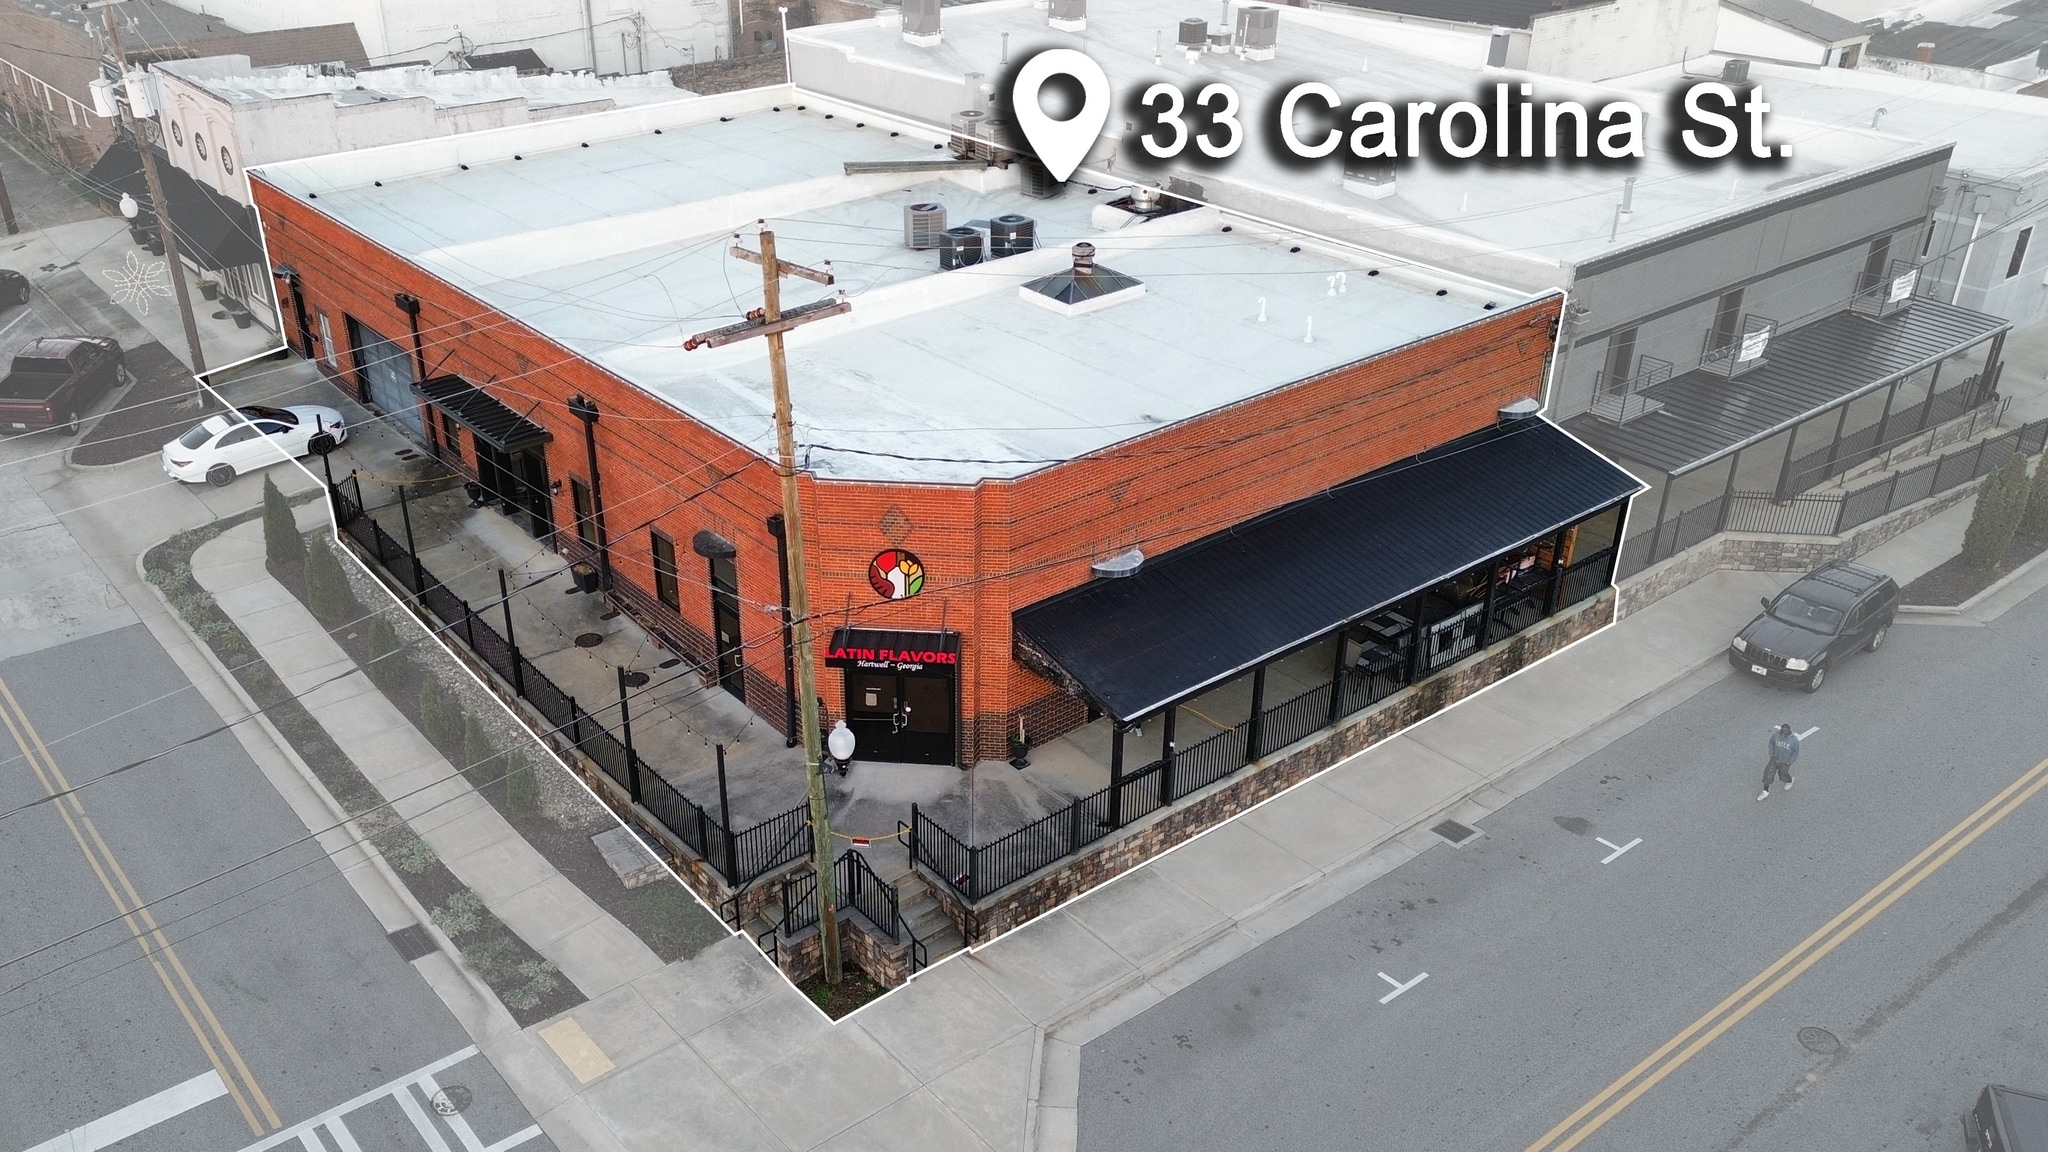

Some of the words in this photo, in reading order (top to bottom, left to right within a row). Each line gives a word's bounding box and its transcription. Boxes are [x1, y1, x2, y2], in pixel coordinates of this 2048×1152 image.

[825, 647, 875, 660] LATIN
[880, 650, 956, 664] FLAVORS
[857, 660, 890, 668] Hartwell
[896, 662, 923, 671] Georgia
